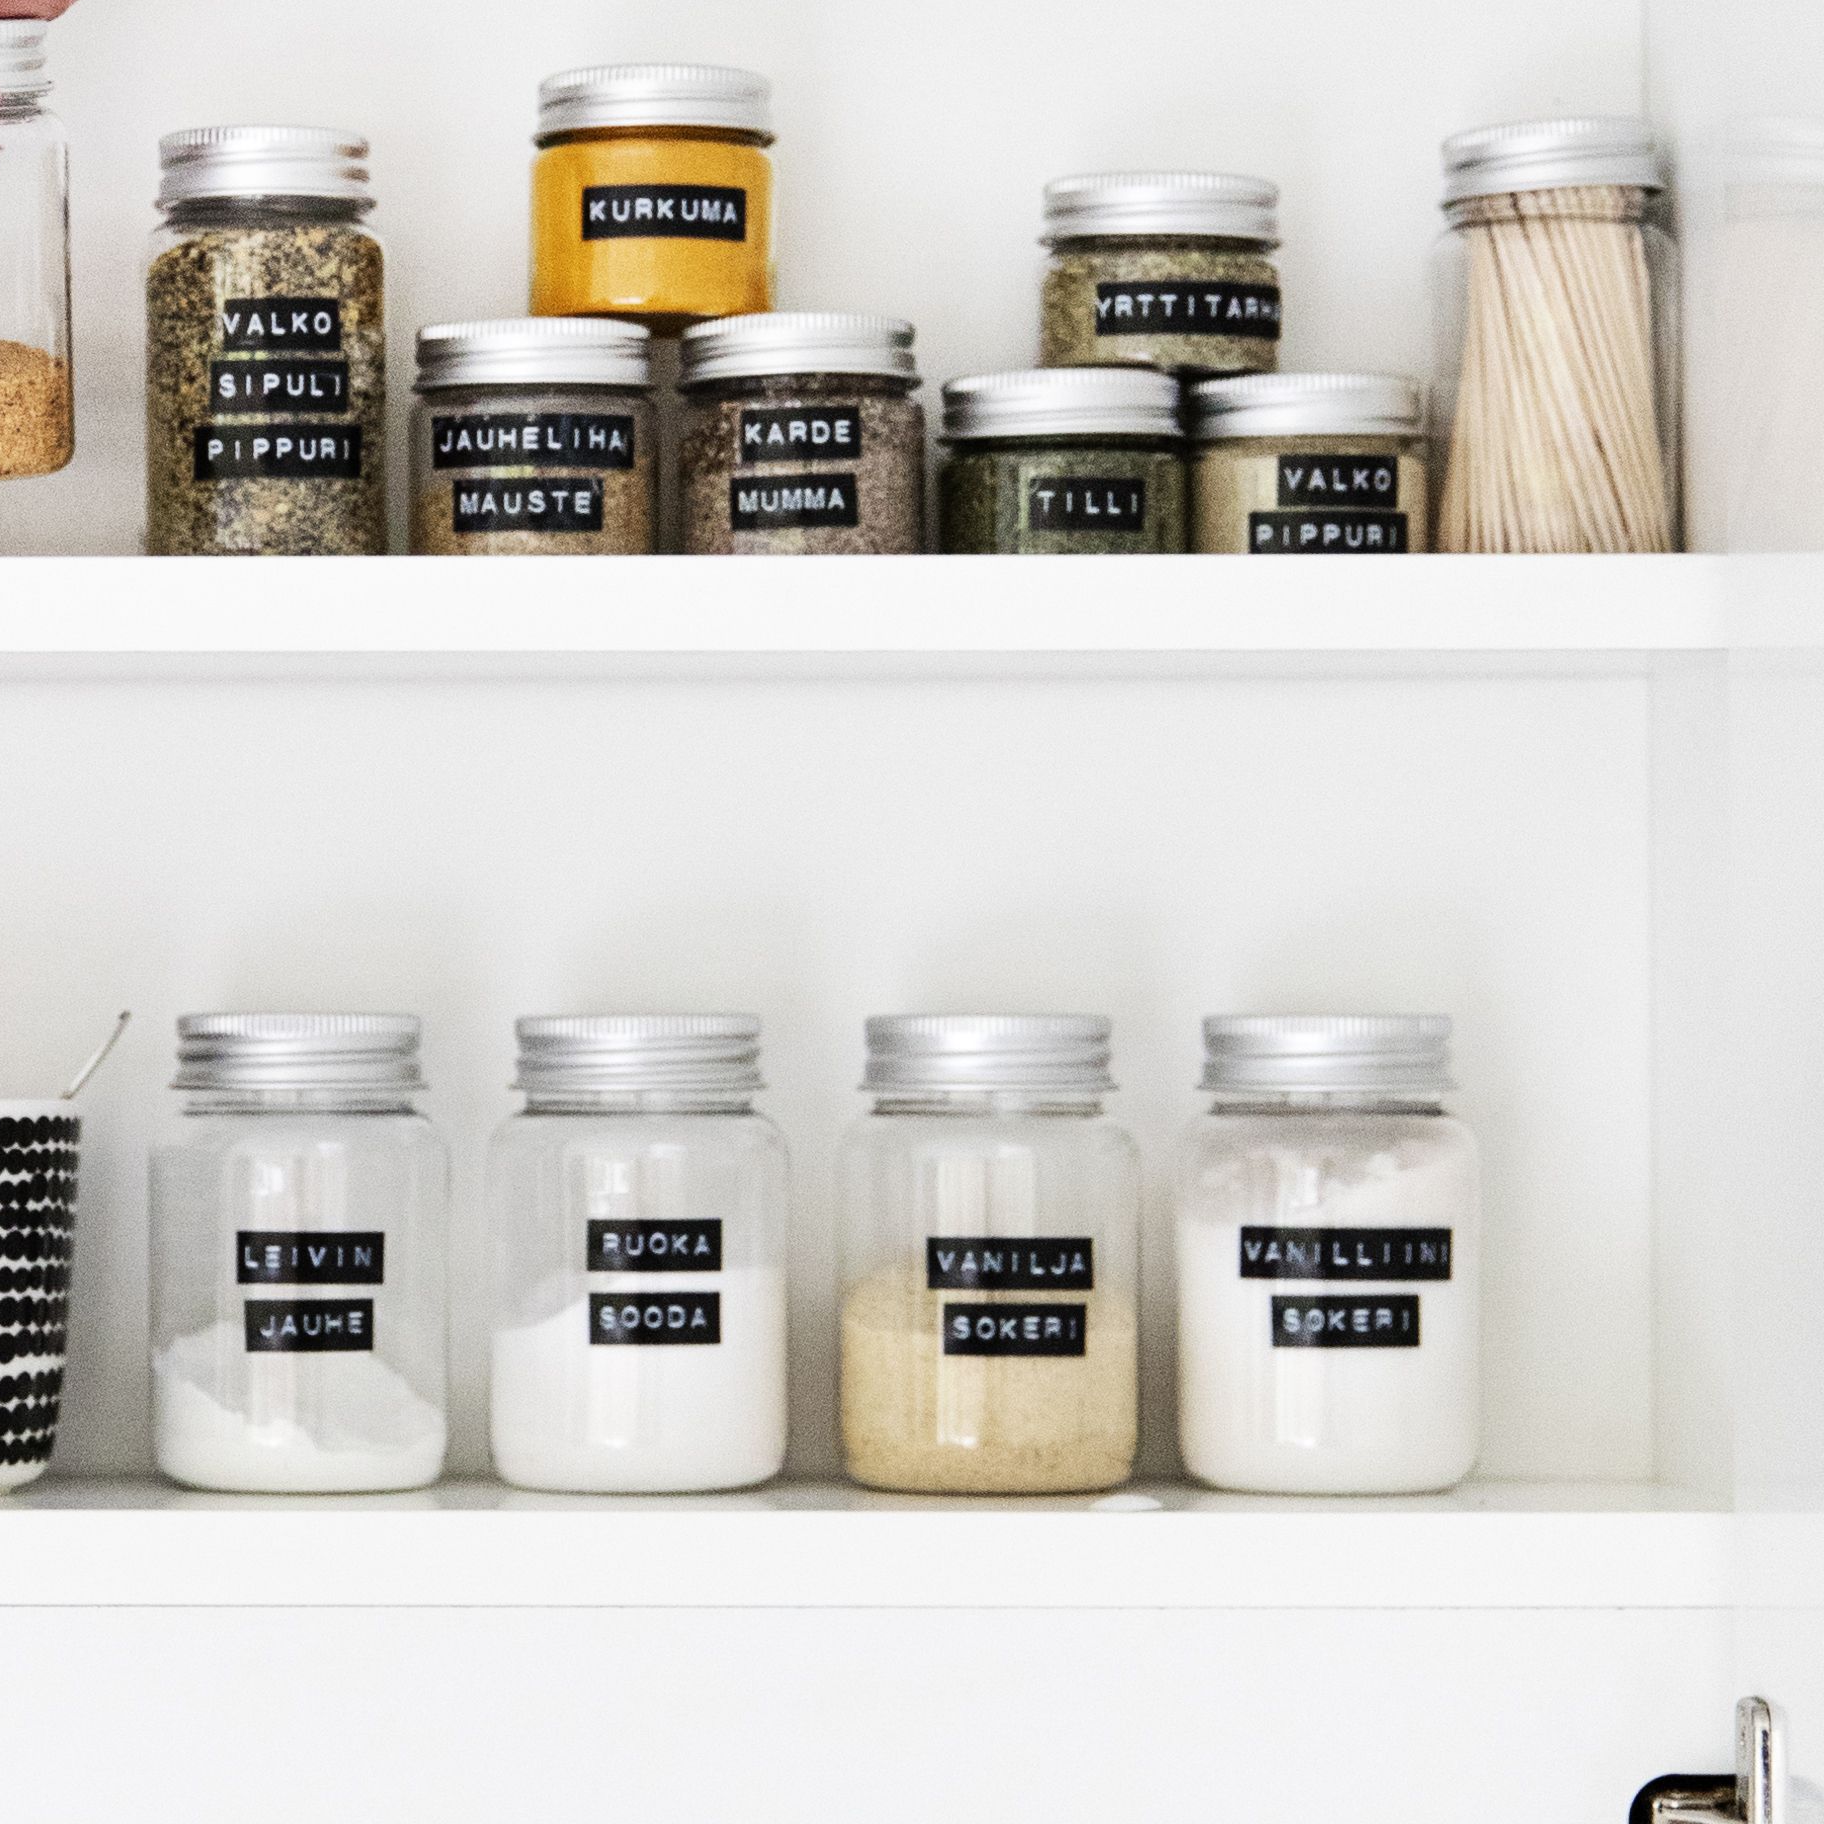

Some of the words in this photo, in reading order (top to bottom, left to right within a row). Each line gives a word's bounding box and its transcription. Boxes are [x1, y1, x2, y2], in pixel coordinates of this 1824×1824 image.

[588, 198, 738, 223] KURKUMA
[222, 310, 332, 336] VALKO
[219, 373, 342, 397] SIPULI
[440, 425, 625, 453] JAUHELIHA
[744, 420, 852, 445] KARDE
[207, 436, 350, 461] PIPPURI
[1283, 467, 1392, 492] VALKO
[459, 489, 592, 515] MAUSTE
[738, 488, 845, 514] MUMMA
[1038, 490, 1138, 515] TILLI
[1255, 523, 1397, 548] PIPPURI
[602, 1232, 711, 1256] RUOKA
[1244, 1239, 1448, 1266] VANILLIINI
[243, 1245, 374, 1269] LEIVIN
[935, 1249, 1086, 1275] VANILJA
[258, 1311, 365, 1338] JAUHE
[599, 1305, 708, 1330] SOODA
[952, 1316, 1077, 1341] SOKERI
[1282, 1307, 1410, 1333] SOKERI
